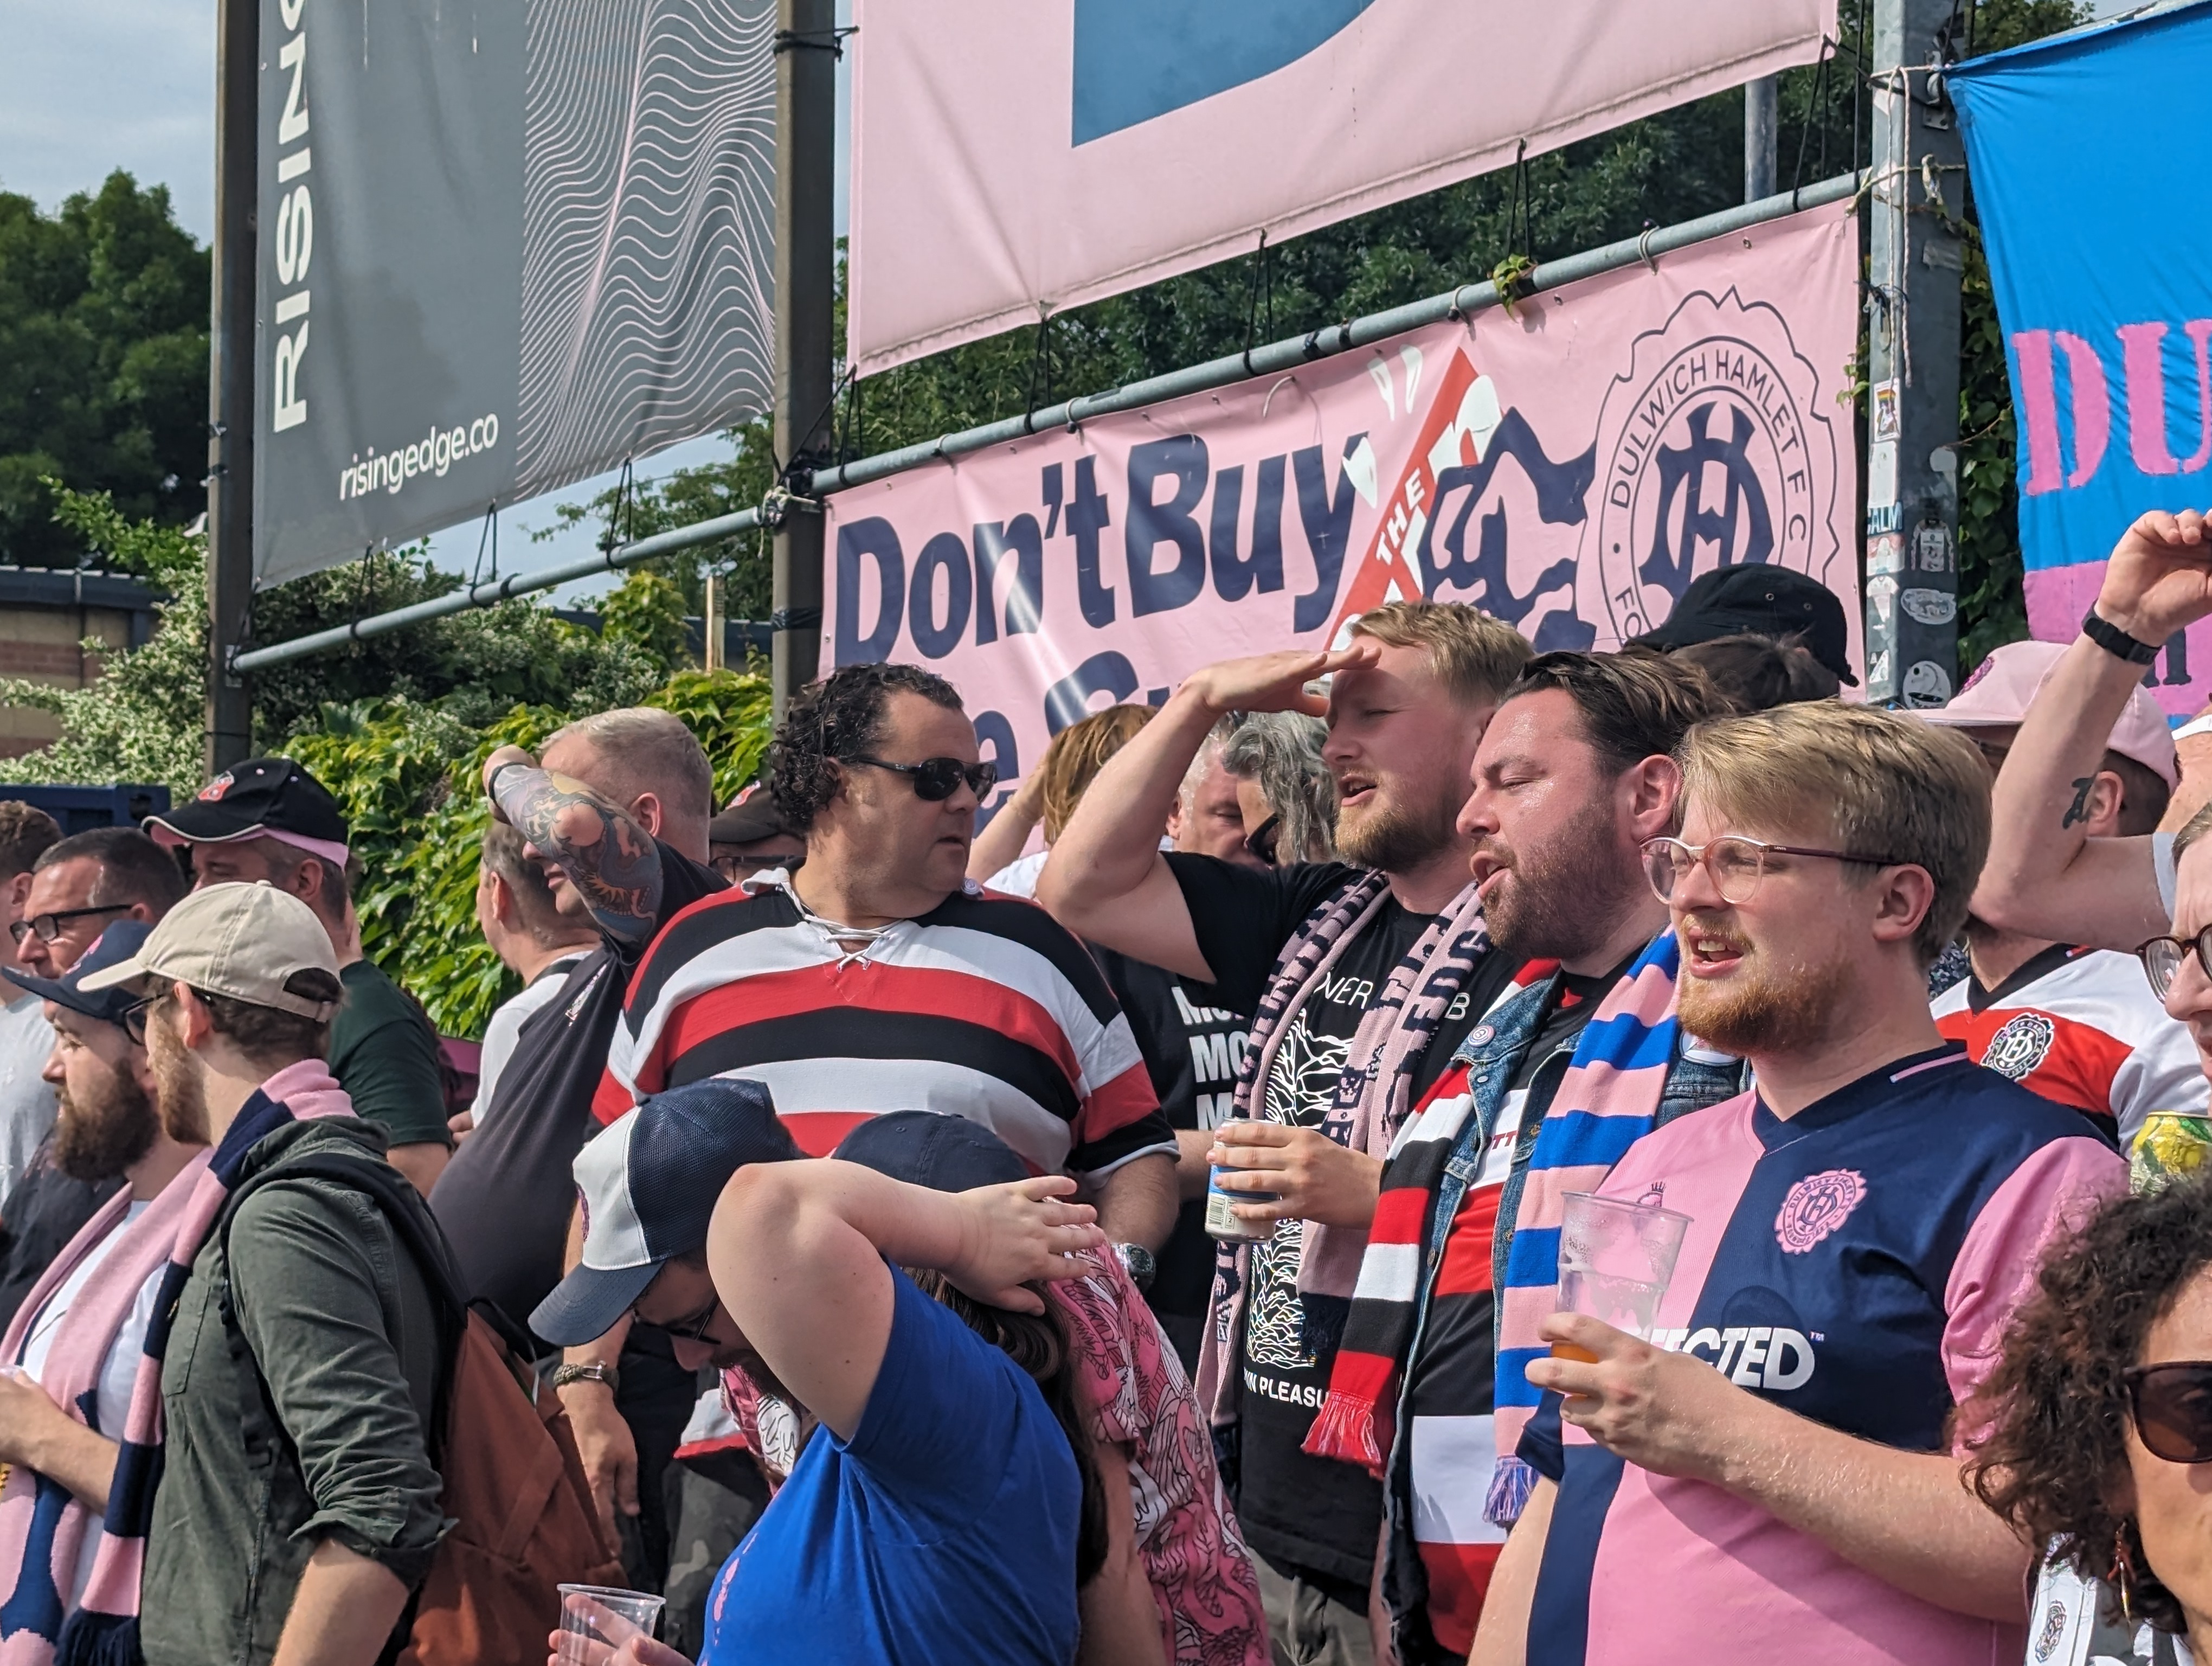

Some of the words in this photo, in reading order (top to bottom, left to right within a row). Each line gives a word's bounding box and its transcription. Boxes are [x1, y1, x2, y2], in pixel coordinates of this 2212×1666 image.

[340, 413, 498, 501] risingedge.co
[1610, 352, 1706, 509] DULWICH
[1716, 349, 1799, 454] HAMLET
[834, 454, 1115, 668] Don't
[1125, 431, 1369, 633] Buy
[1376, 467, 1426, 565] THE
